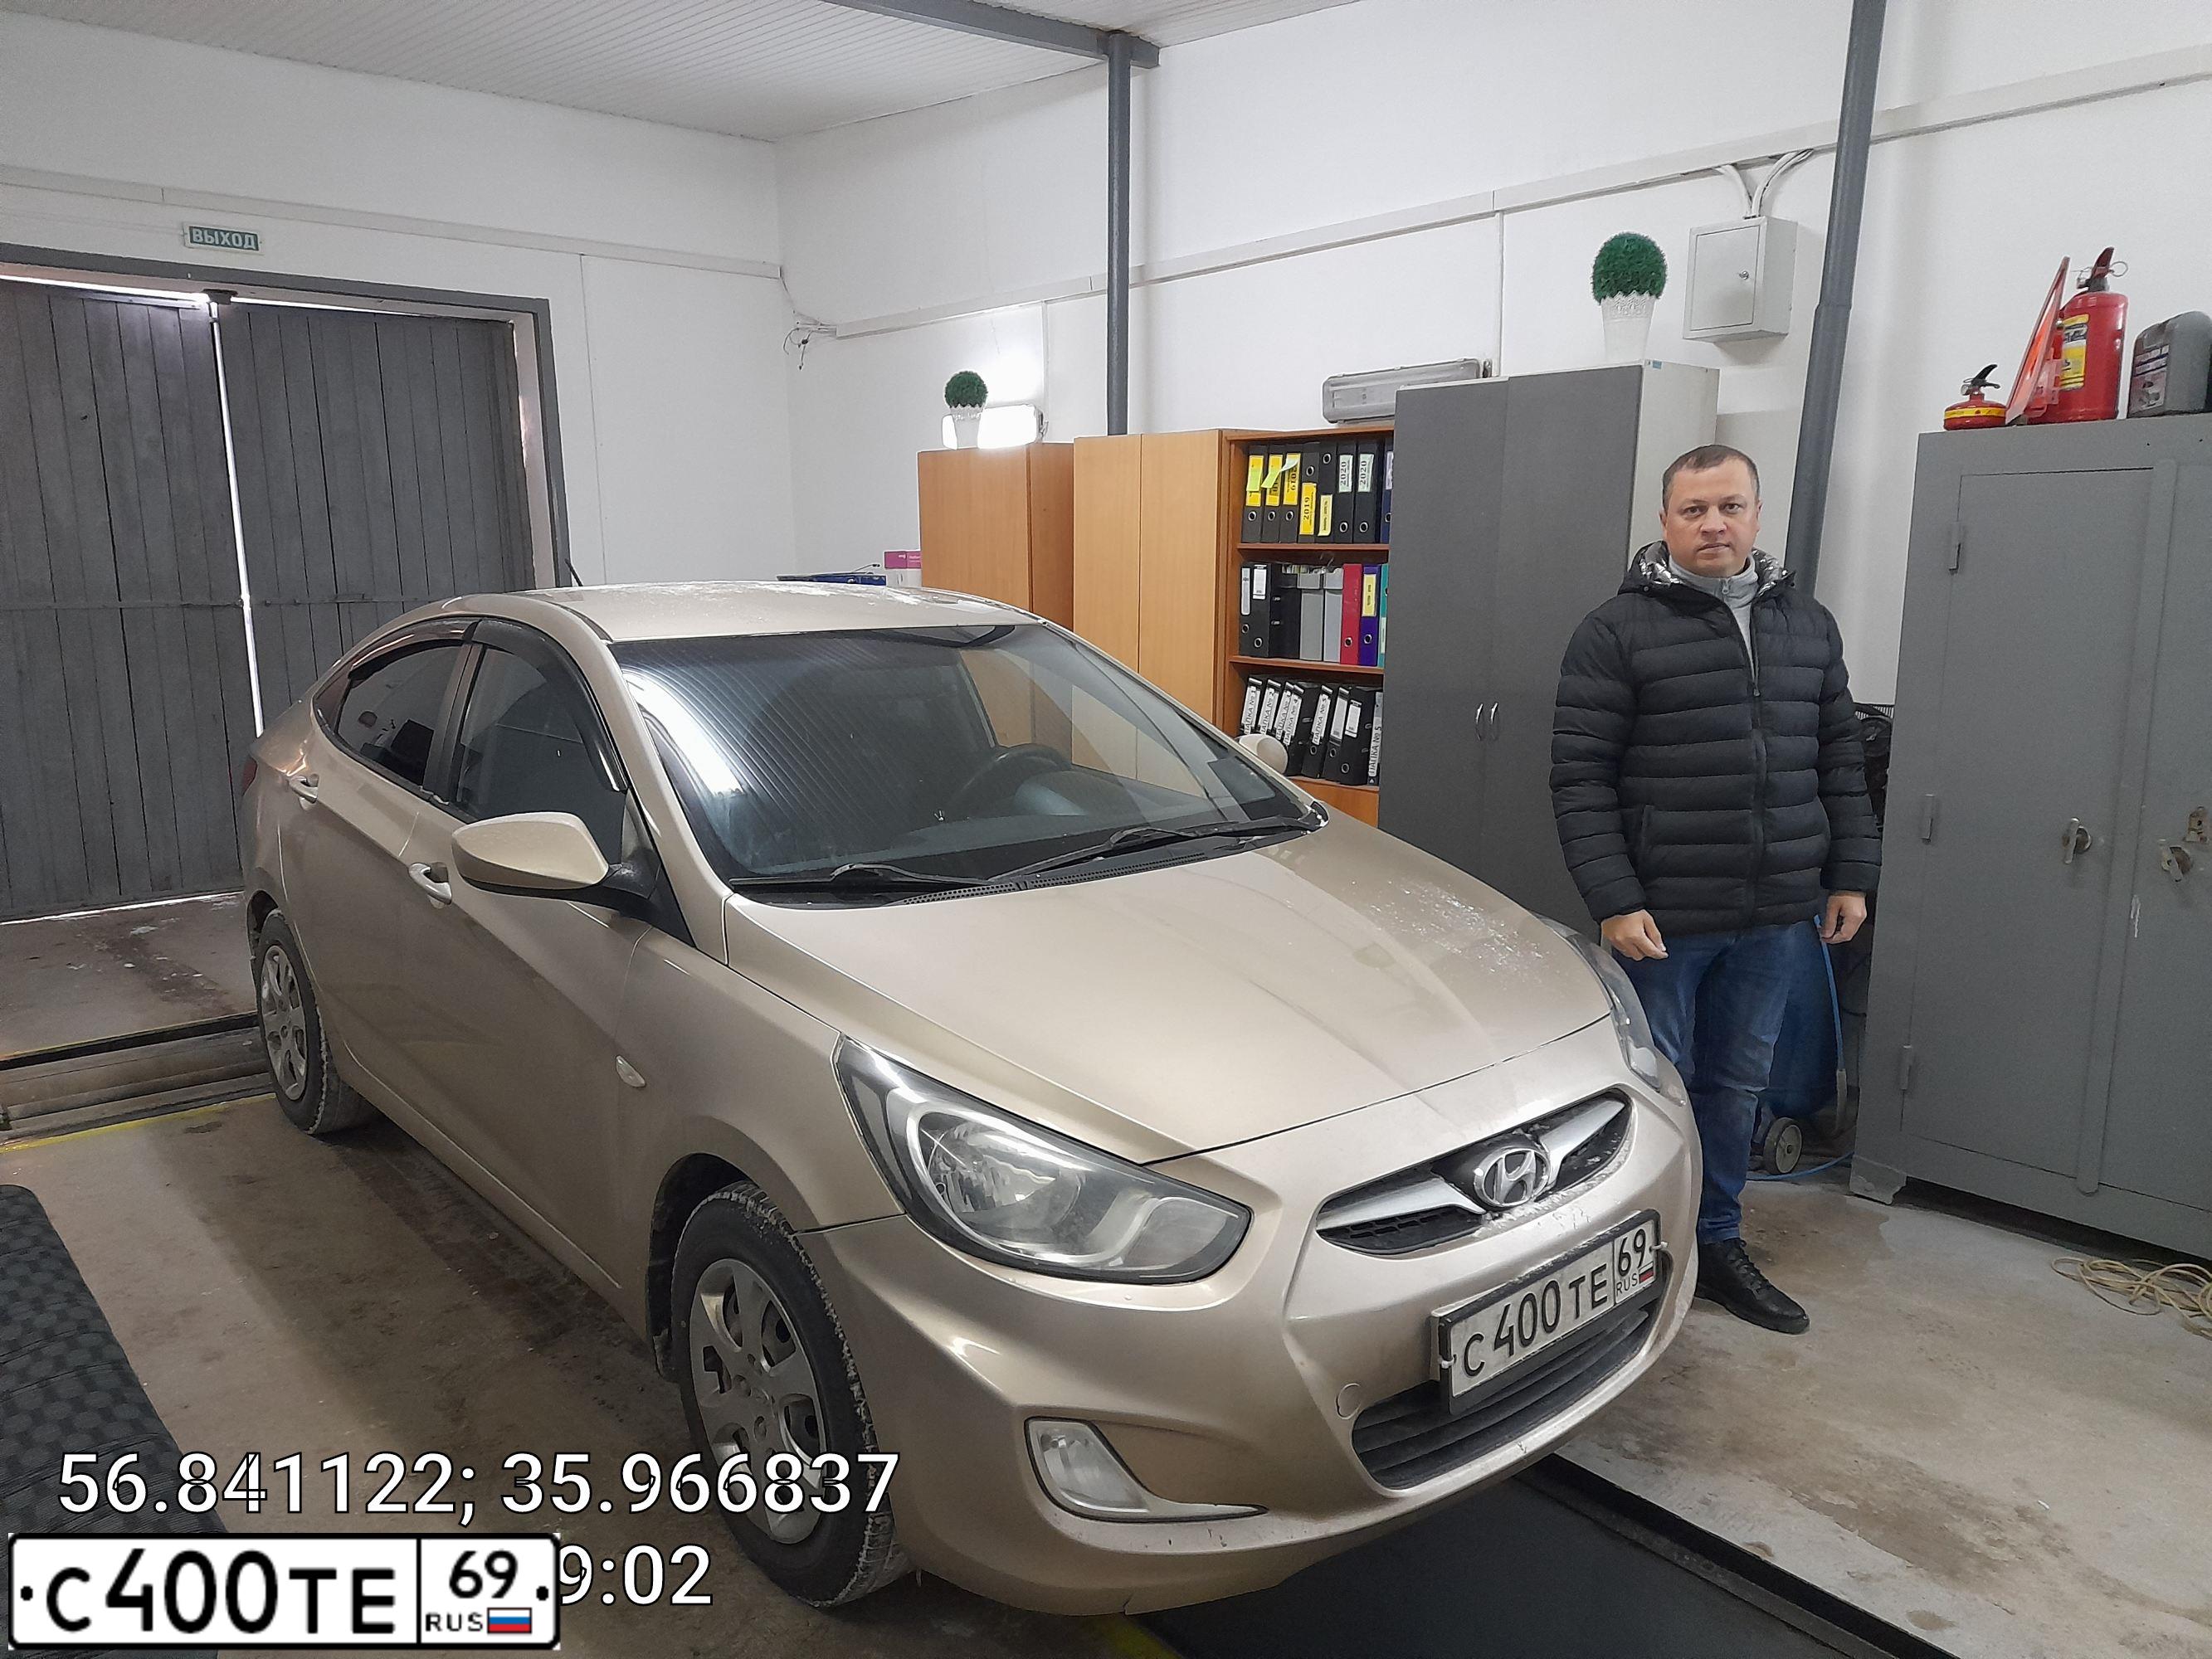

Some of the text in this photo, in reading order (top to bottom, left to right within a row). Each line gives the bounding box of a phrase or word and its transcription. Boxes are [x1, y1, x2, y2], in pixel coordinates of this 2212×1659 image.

[192, 228, 256, 249] ВЫХОД
[1313, 716, 1323, 743] ПАПКА
[1369, 746, 1378, 776] ПАПКА
[1617, 1228, 1646, 1277] 69
[1616, 1272, 1639, 1295] RUS
